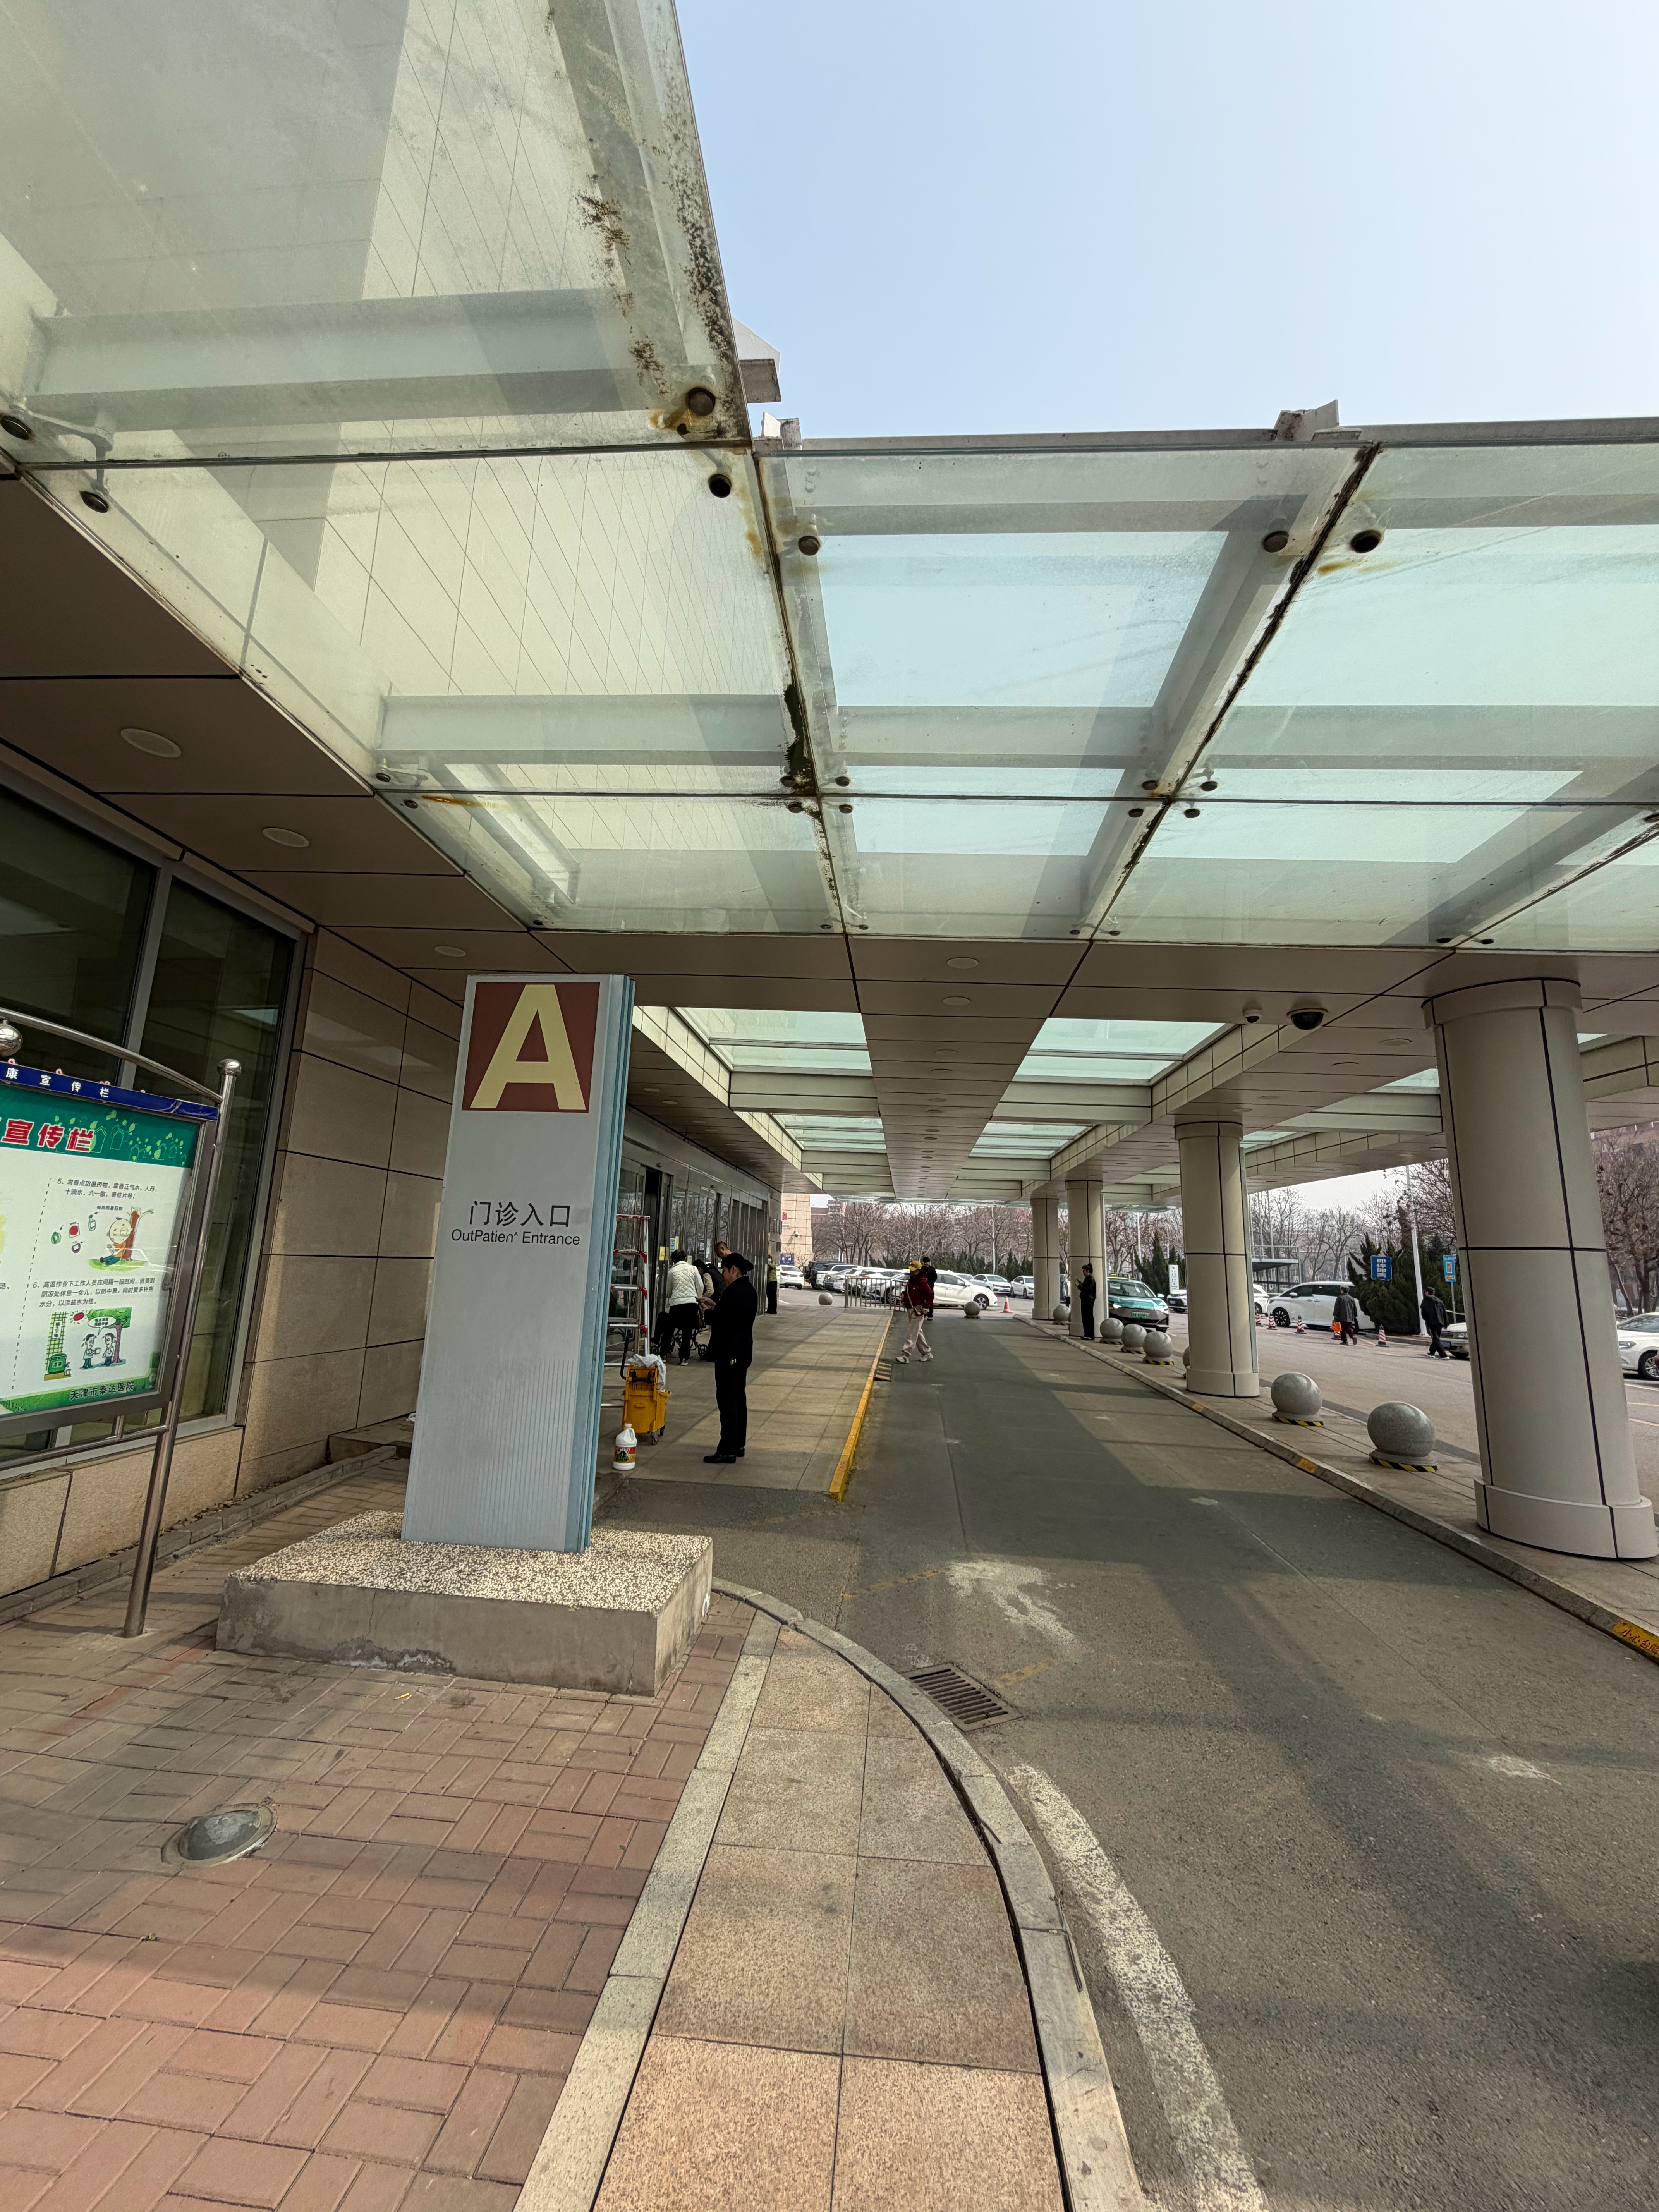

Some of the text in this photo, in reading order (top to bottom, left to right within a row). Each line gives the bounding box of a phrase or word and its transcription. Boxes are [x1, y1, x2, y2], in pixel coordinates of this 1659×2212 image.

[470, 984, 586, 1110] A
[6, 1068, 109, 1097] 康宣传栏
[1, 1119, 94, 1153] 宣传栏
[469, 1200, 570, 1227] 门诊入口
[522, 1231, 580, 1245] Entrance
[70, 1381, 135, 1400] 天津市泰达医院
